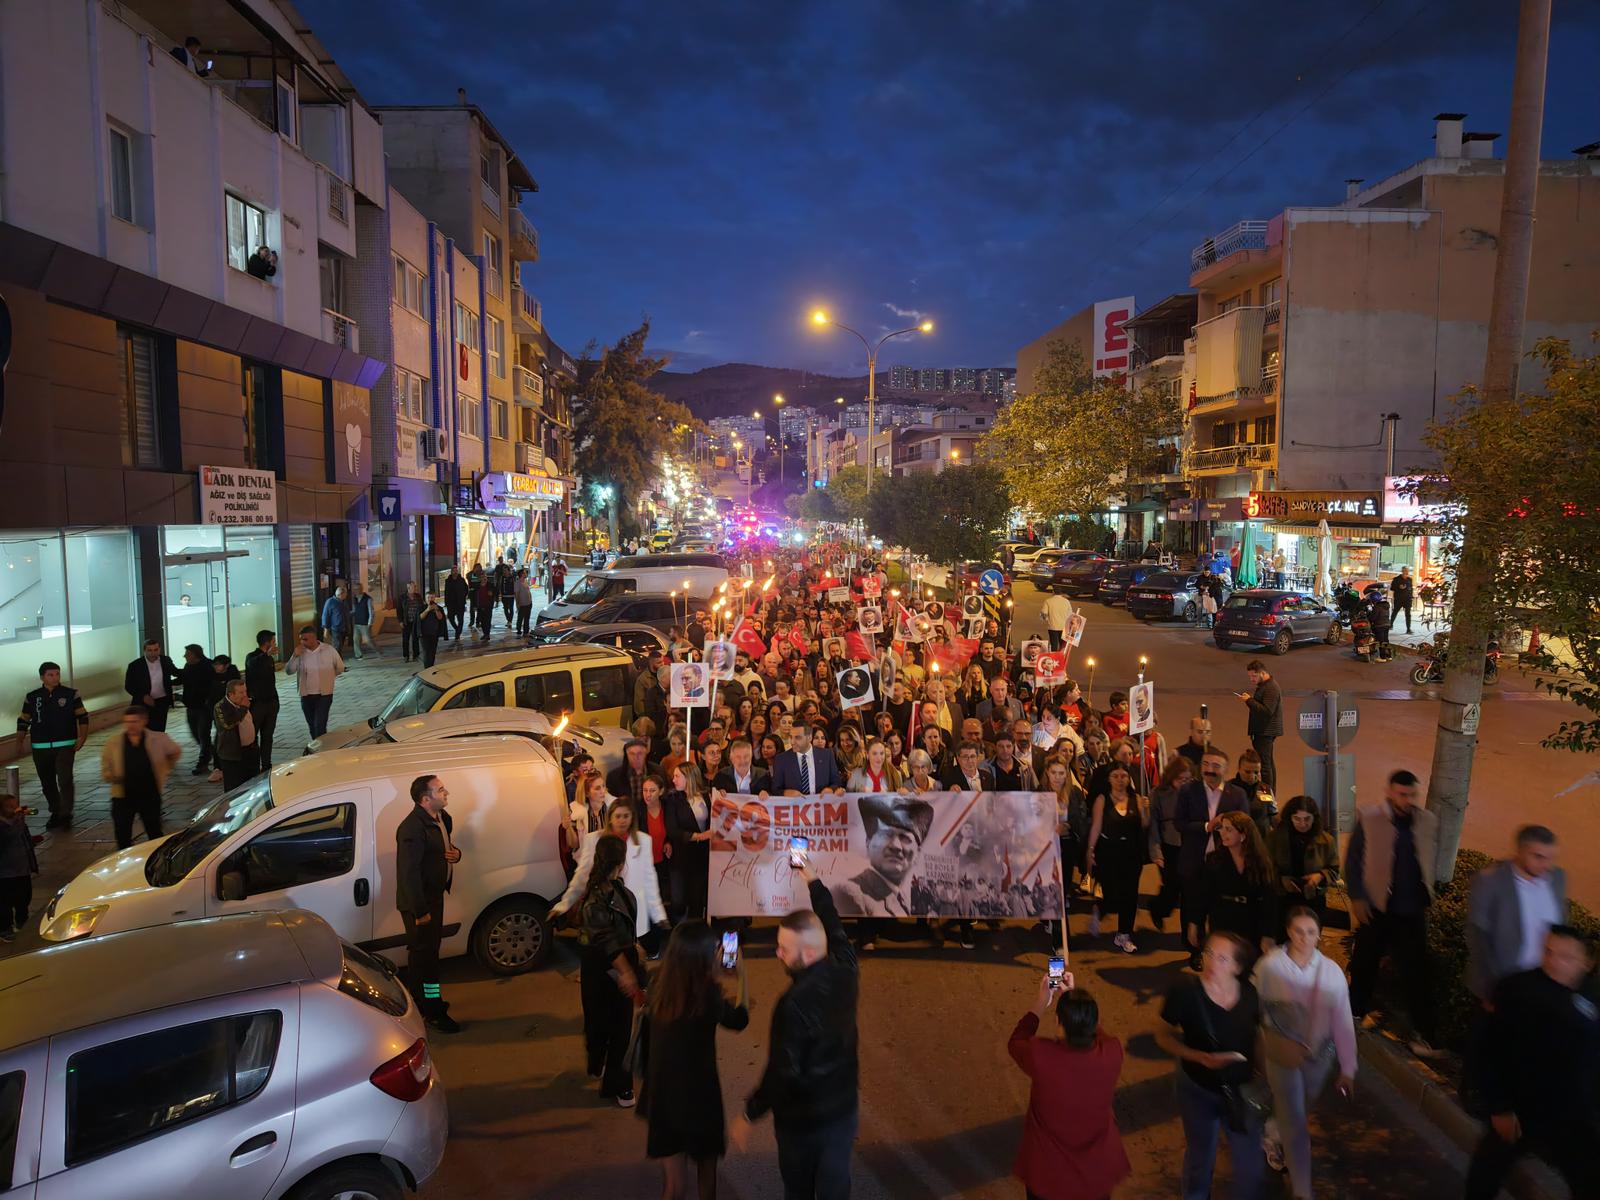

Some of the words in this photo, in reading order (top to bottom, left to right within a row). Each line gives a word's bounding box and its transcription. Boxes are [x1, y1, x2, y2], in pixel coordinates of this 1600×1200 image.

[238, 475, 273, 489] DENTAL
[210, 490, 225, 500] AĞIZ
[227, 492, 235, 500] ve
[236, 491, 247, 501] DİŞ
[1247, 493, 1259, 517] 5
[255, 515, 264, 523] 00
[709, 799, 771, 852] 29
[774, 827, 849, 838] CUMHURİYET
[773, 838, 849, 853] BARAMI
